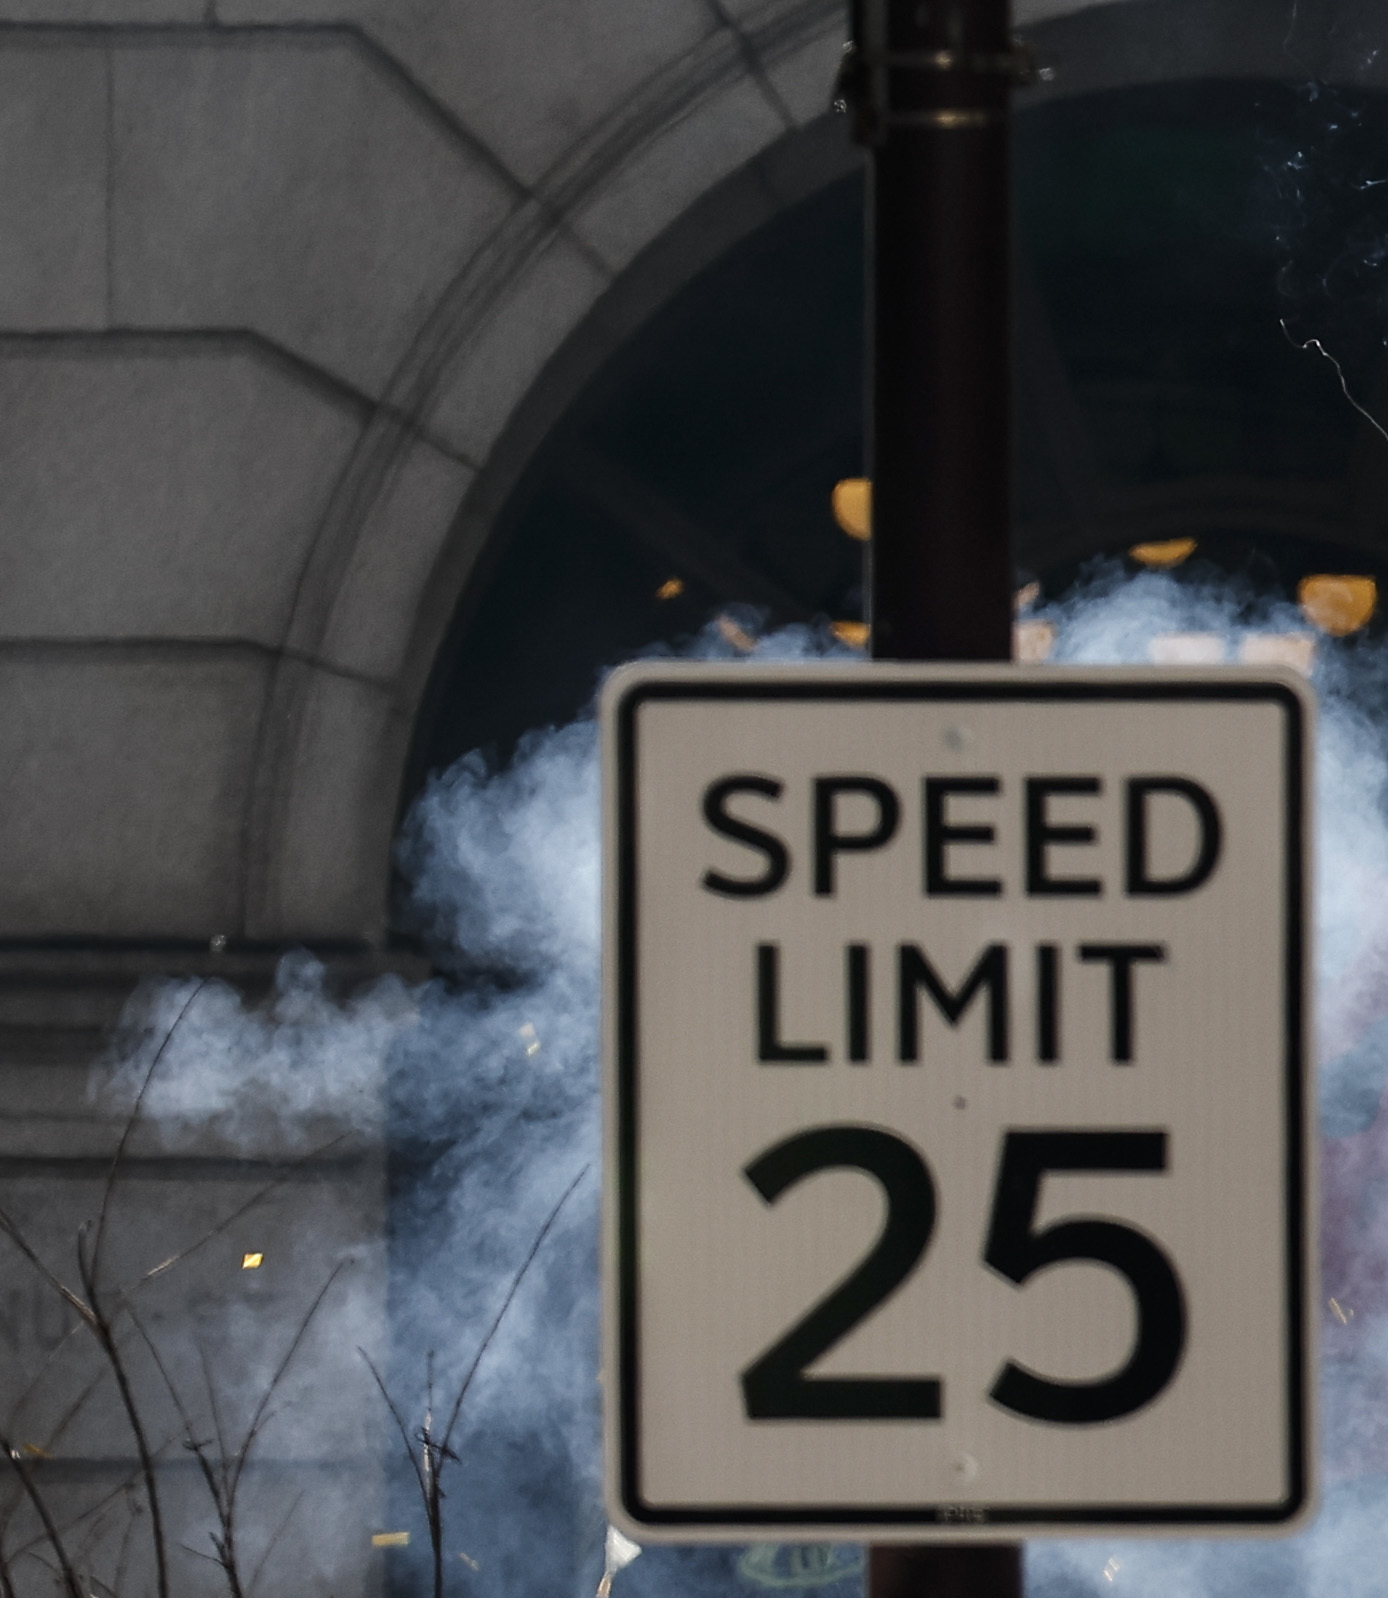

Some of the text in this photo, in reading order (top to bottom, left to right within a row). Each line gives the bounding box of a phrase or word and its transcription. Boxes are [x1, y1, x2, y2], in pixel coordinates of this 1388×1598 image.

[701, 774, 1224, 900] SPEED
[755, 942, 1170, 1066] LIMIT
[739, 1121, 1190, 1427] 25
